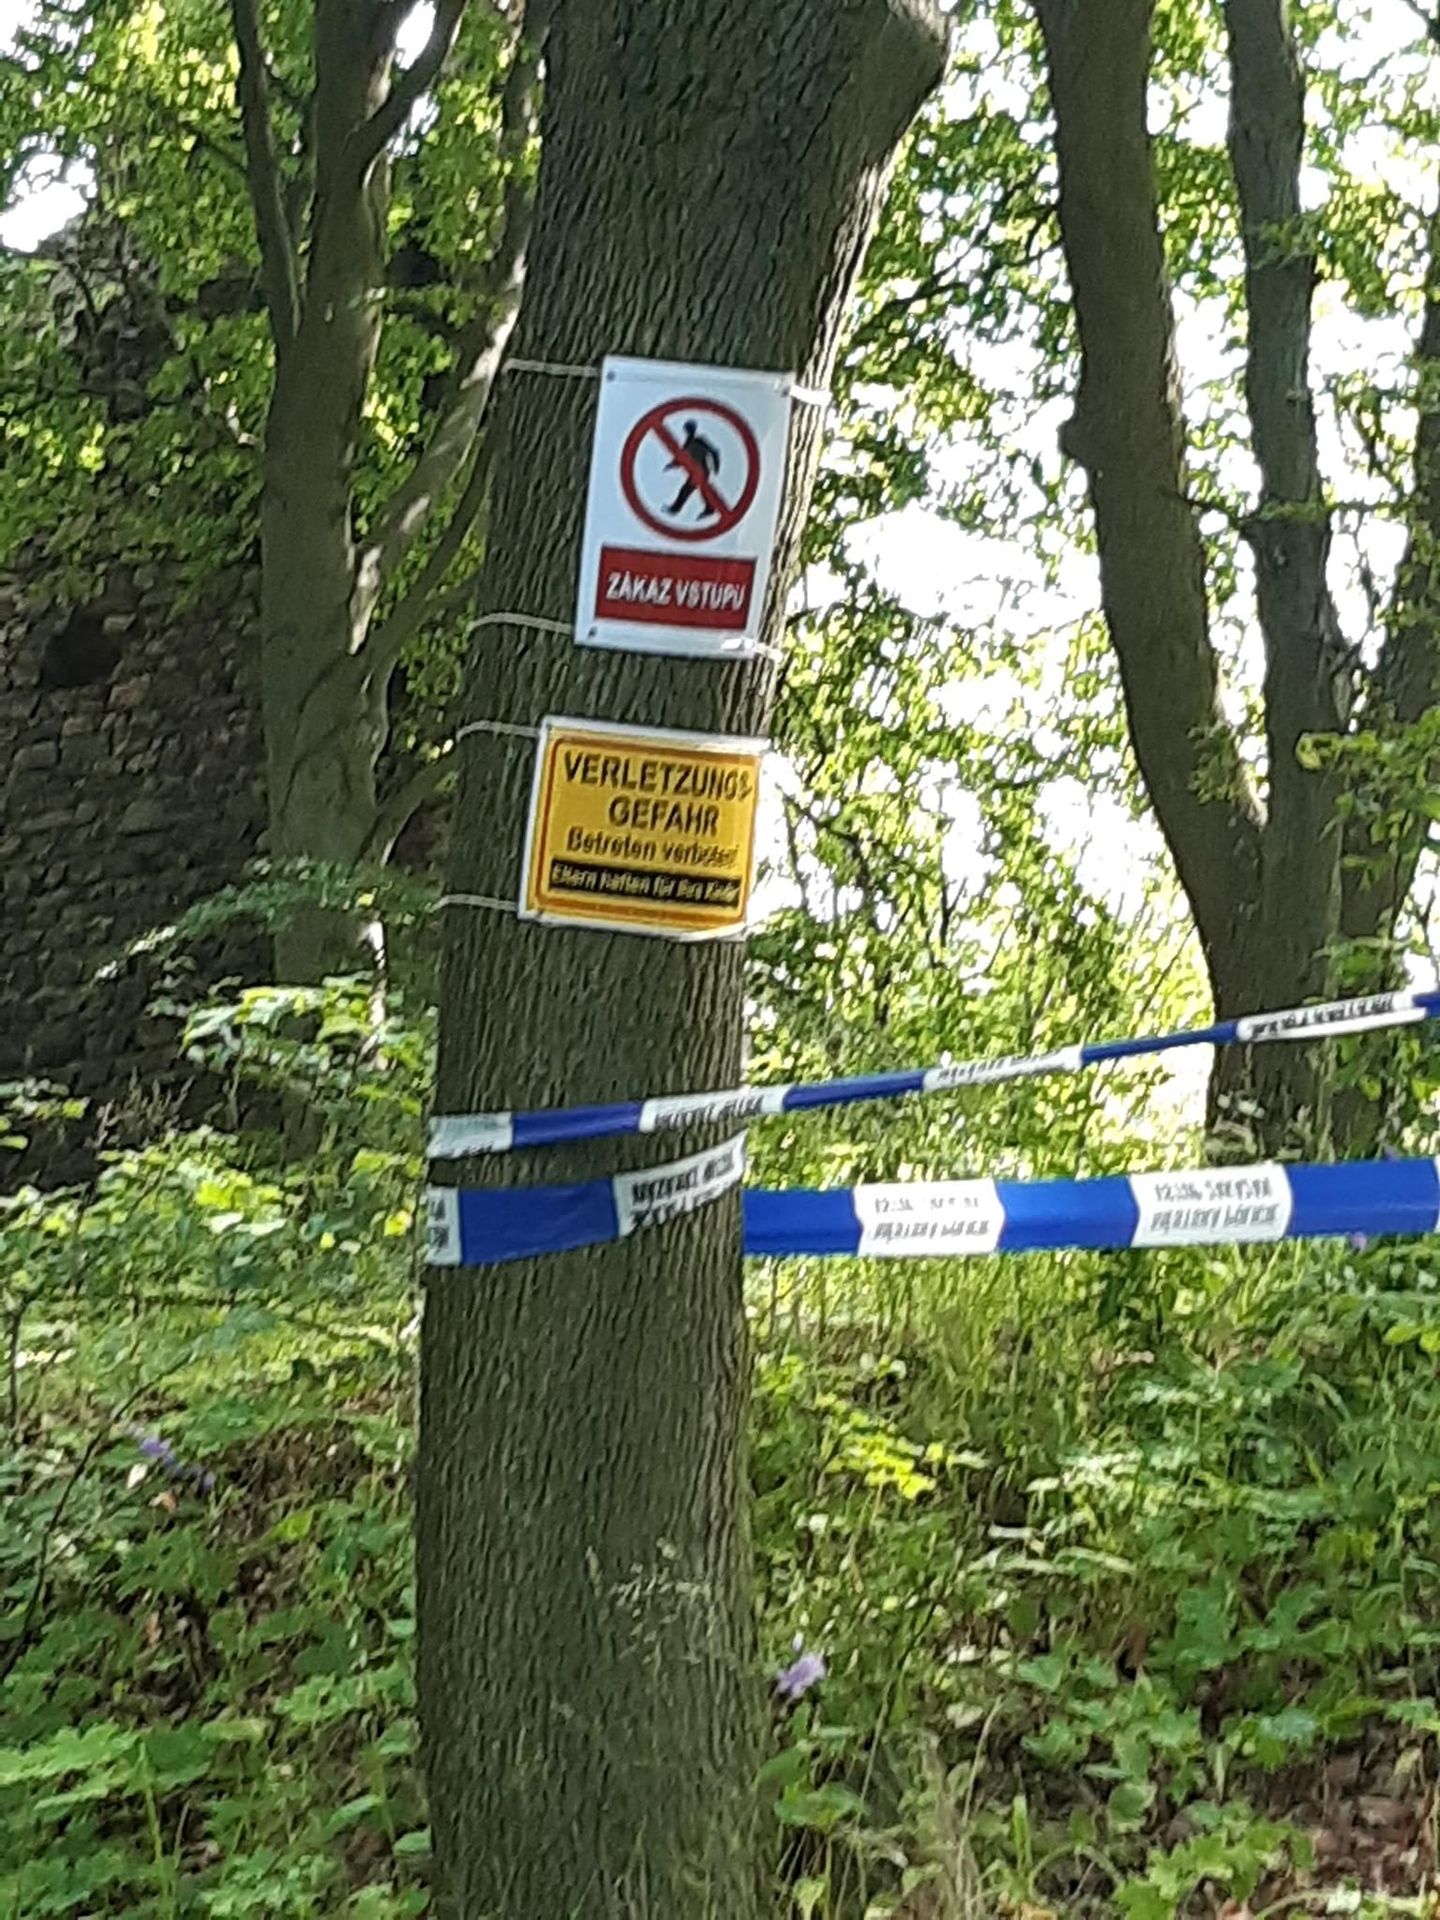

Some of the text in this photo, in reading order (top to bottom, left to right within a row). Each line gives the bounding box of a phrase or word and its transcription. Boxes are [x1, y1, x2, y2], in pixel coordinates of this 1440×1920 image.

[675, 578, 746, 611] VSTUPU
[608, 795, 720, 837] GEFAHR
[567, 826, 657, 861] Betreten
